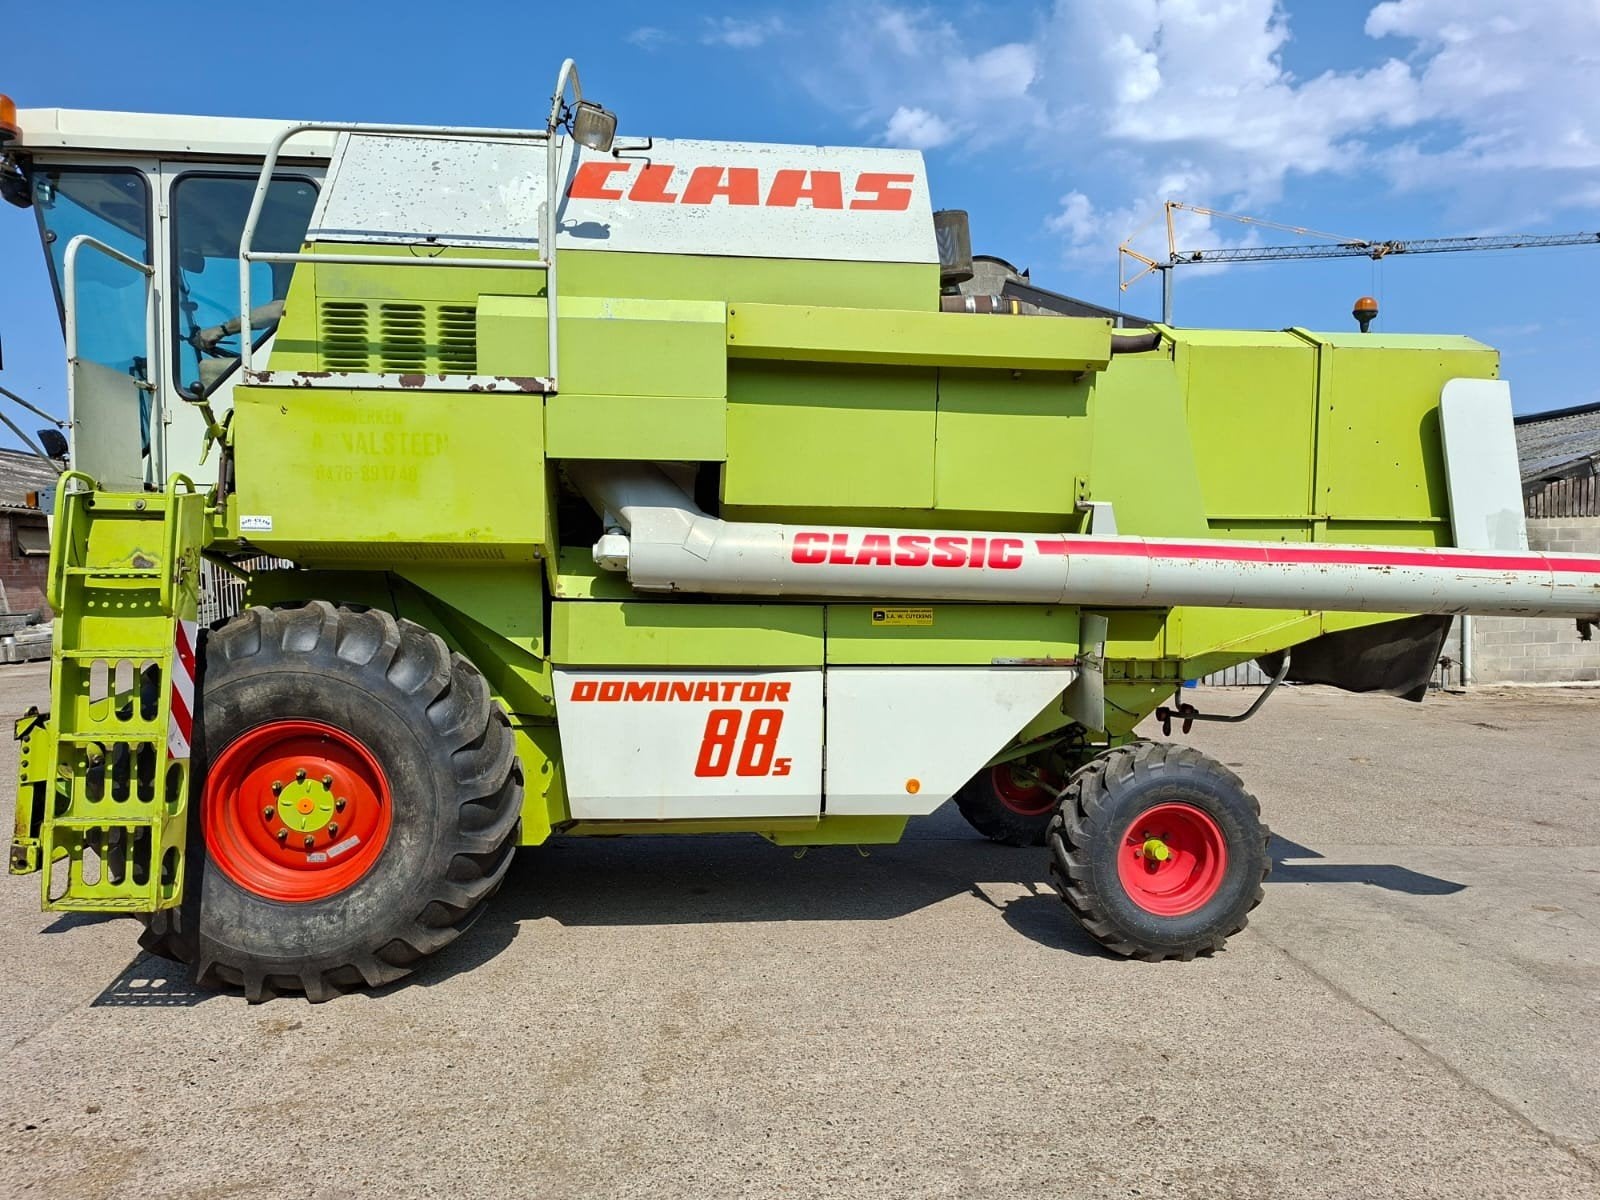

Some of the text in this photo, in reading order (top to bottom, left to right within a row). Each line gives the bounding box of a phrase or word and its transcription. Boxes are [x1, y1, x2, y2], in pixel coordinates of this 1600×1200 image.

[565, 161, 915, 211] CLAAS
[791, 532, 1024, 570] CLASSIC
[570, 681, 792, 702] DOMINATOR
